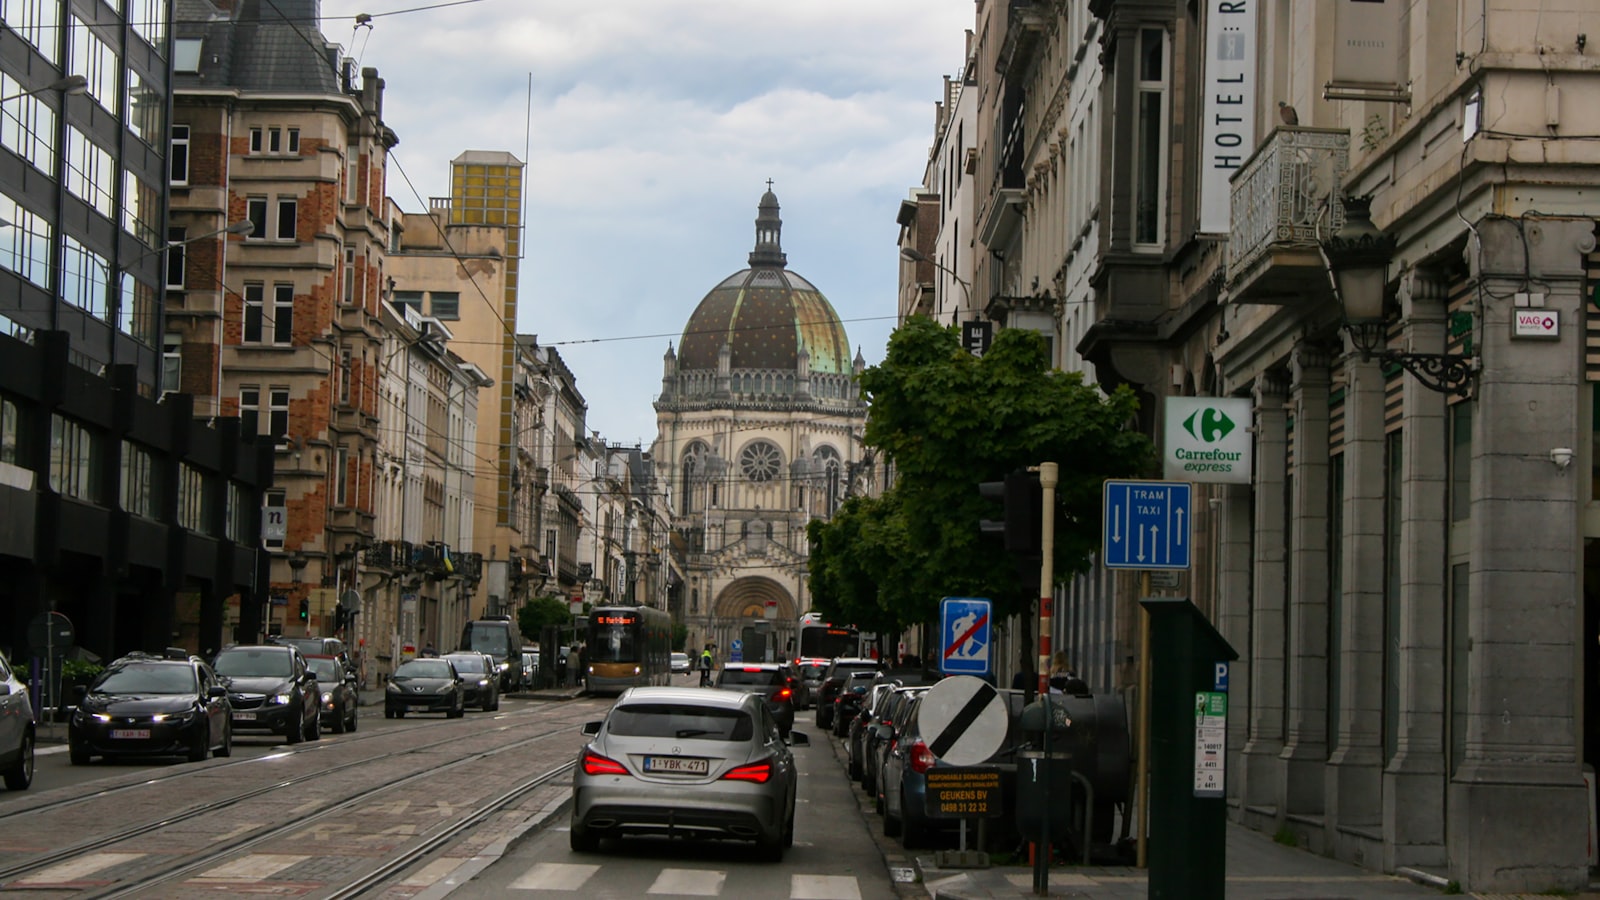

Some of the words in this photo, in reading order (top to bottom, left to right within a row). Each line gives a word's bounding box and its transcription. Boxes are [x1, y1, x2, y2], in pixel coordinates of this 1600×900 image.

[1214, 73, 1244, 169] HOTEL
[1519, 316, 1541, 325] VAG
[1175, 448, 1242, 461] Carrefour
[1184, 462, 1232, 474] express
[1134, 490, 1164, 500] TRAM
[1137, 505, 1161, 515] TAXI
[1215, 662, 1228, 684] P
[940, 790, 976, 801] GEUKENS
[976, 790, 988, 801] BV
[958, 802, 967, 812] 31
[968, 802, 978, 812] 22
[978, 802, 987, 812] 32
